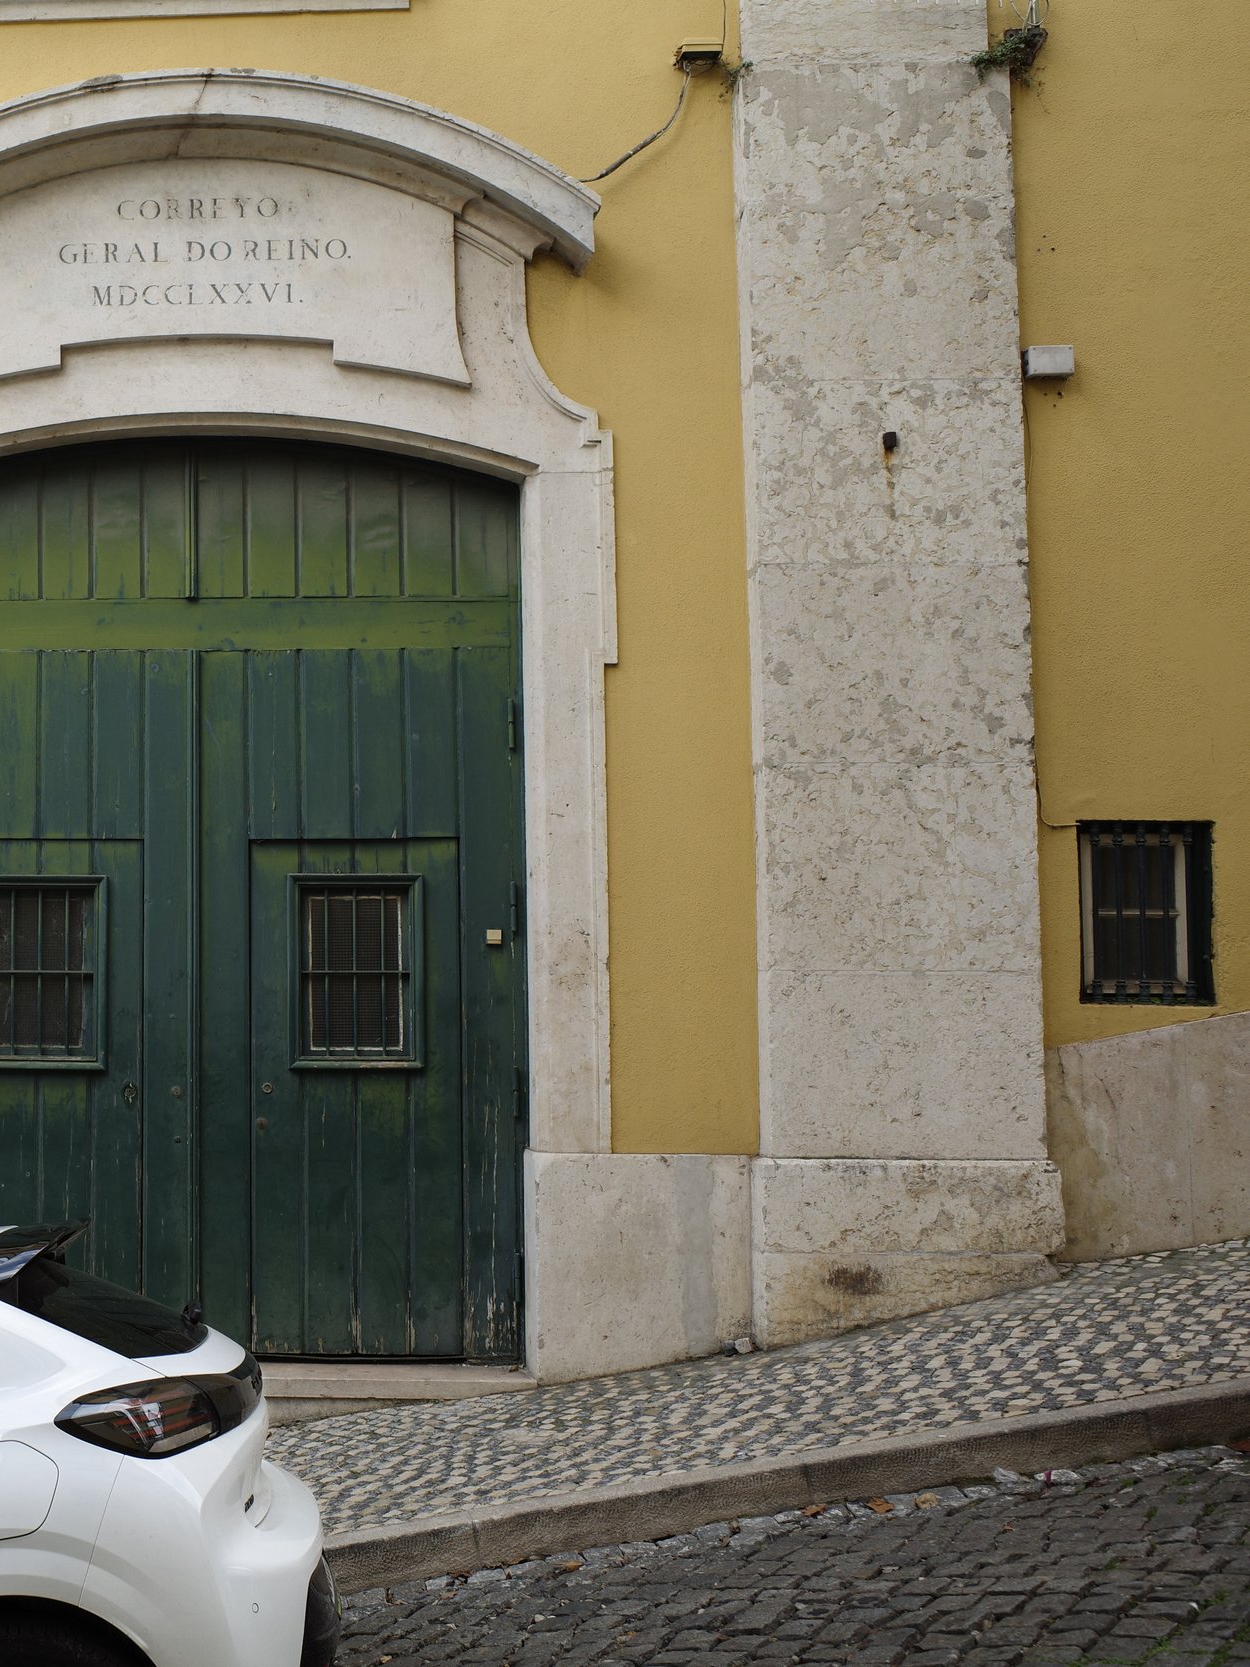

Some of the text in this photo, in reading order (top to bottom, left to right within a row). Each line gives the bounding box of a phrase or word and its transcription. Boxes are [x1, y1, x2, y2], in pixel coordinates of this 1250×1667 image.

[59, 238, 351, 264] GERAL DO REINO.
[91, 283, 303, 306] MDCCLXXVI.
